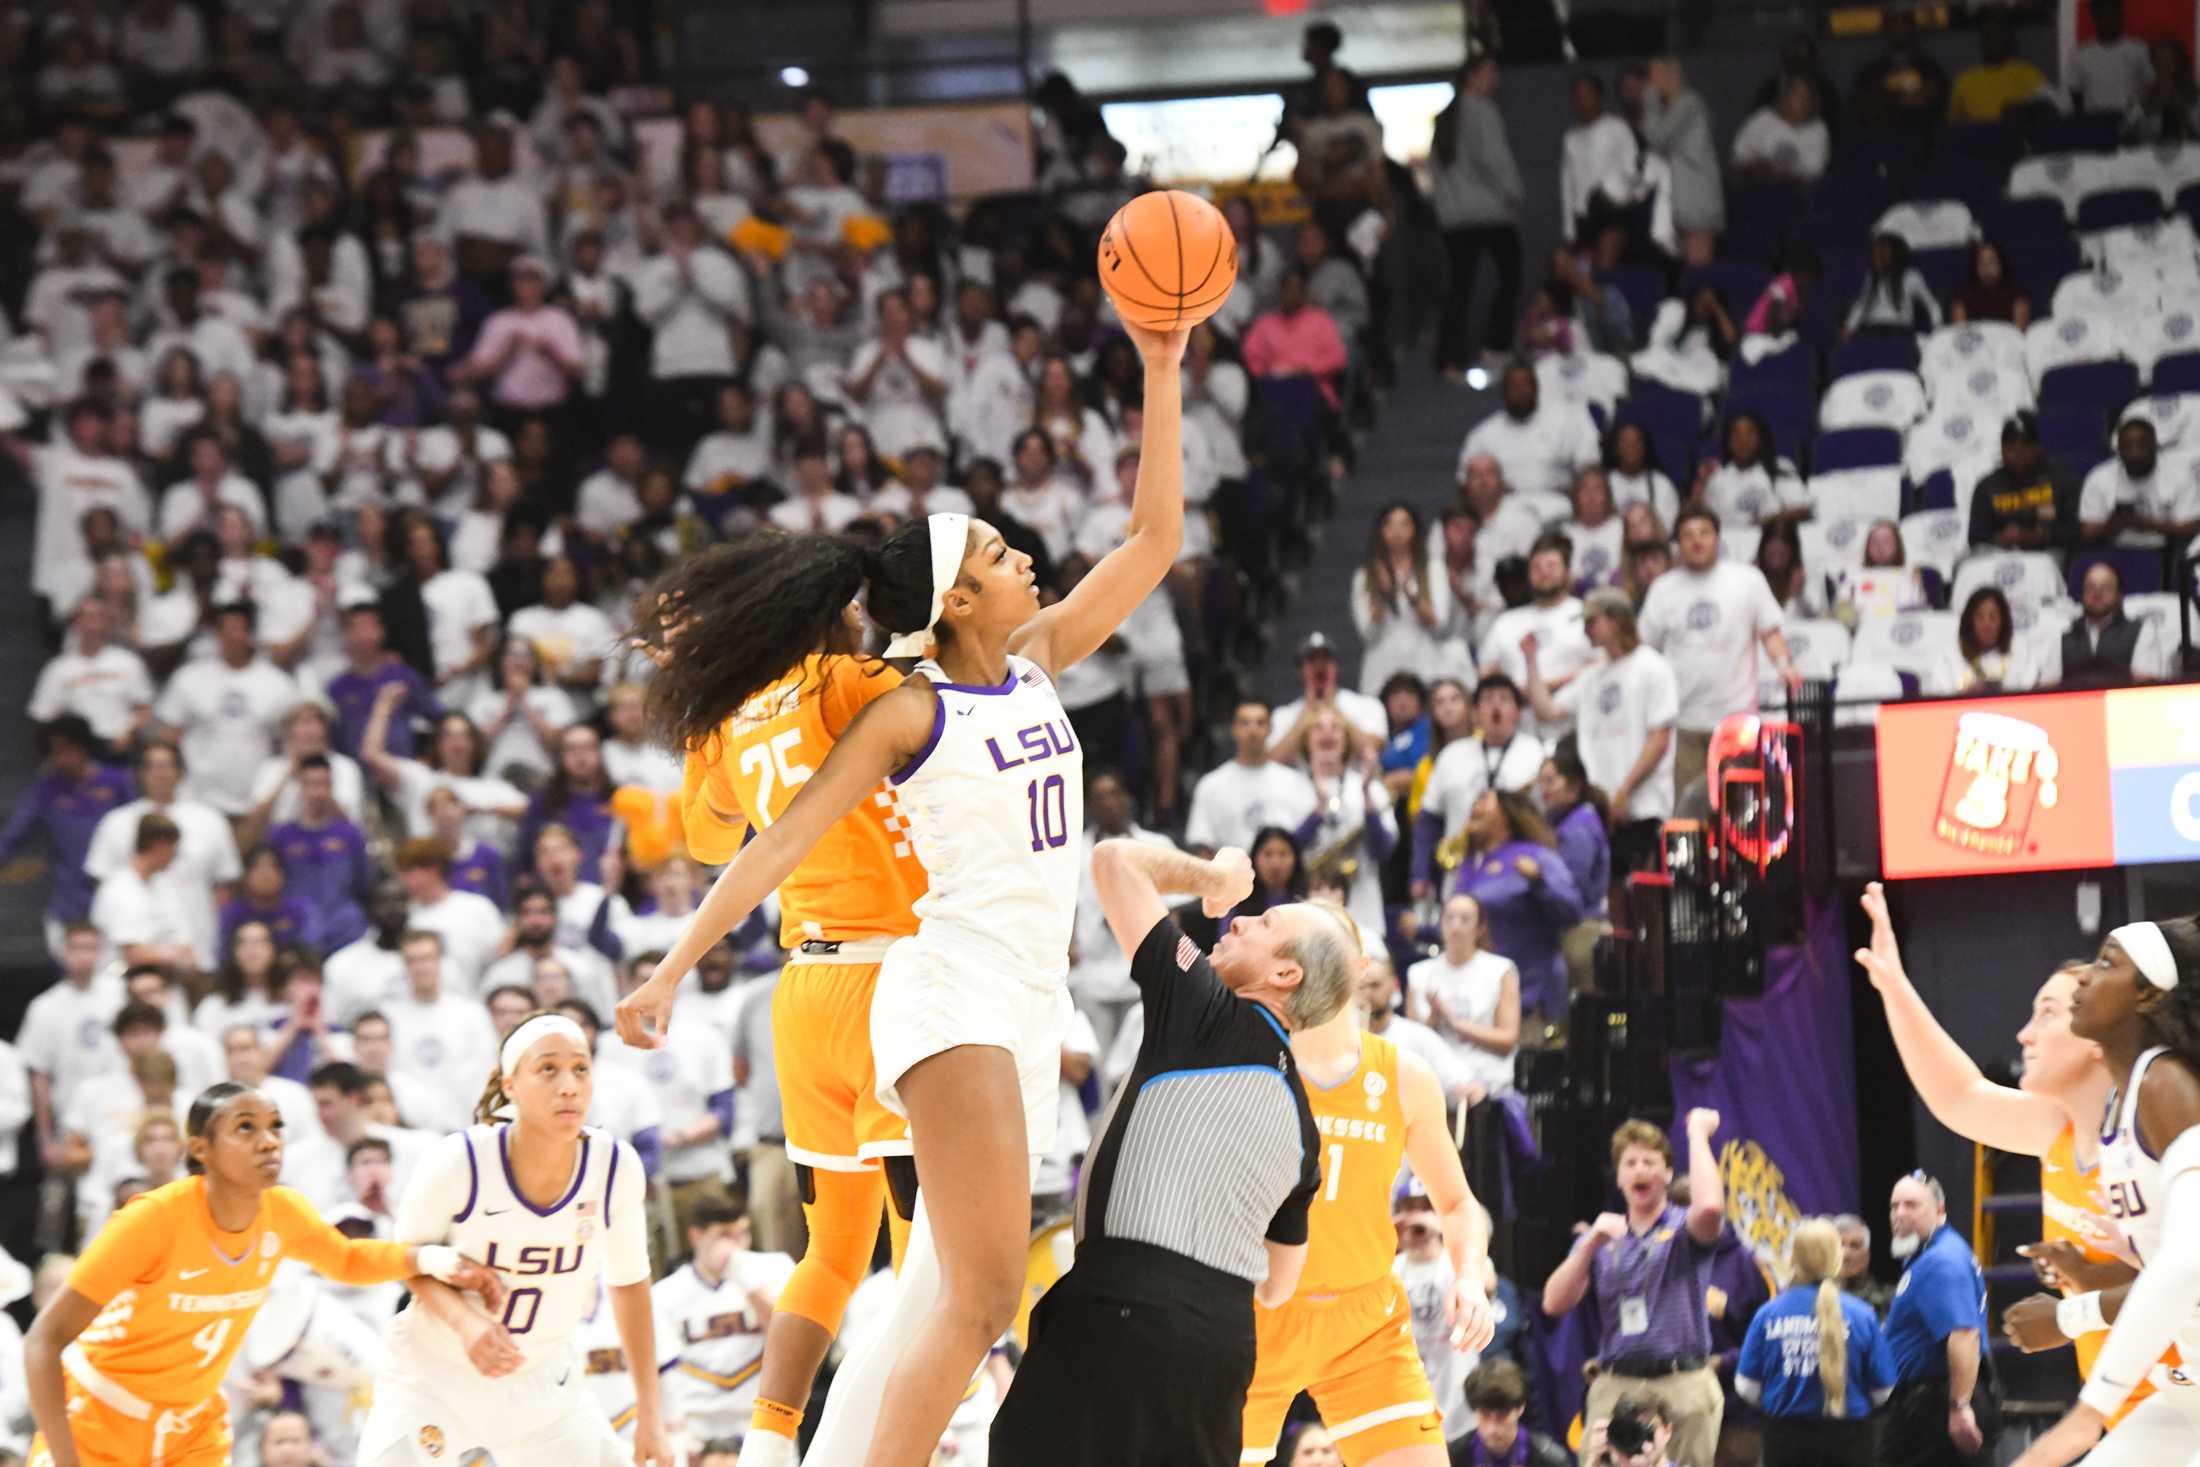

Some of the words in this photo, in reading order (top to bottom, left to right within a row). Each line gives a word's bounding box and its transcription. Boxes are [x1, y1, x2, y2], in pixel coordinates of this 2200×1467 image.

[985, 718, 1074, 772] LSU
[739, 727, 815, 829] 25
[1028, 774, 1067, 852] 10
[2110, 1179, 2147, 1219] SU
[486, 1241, 584, 1274] LSU
[502, 1287, 543, 1334] 0
[192, 1318, 231, 1368] 4
